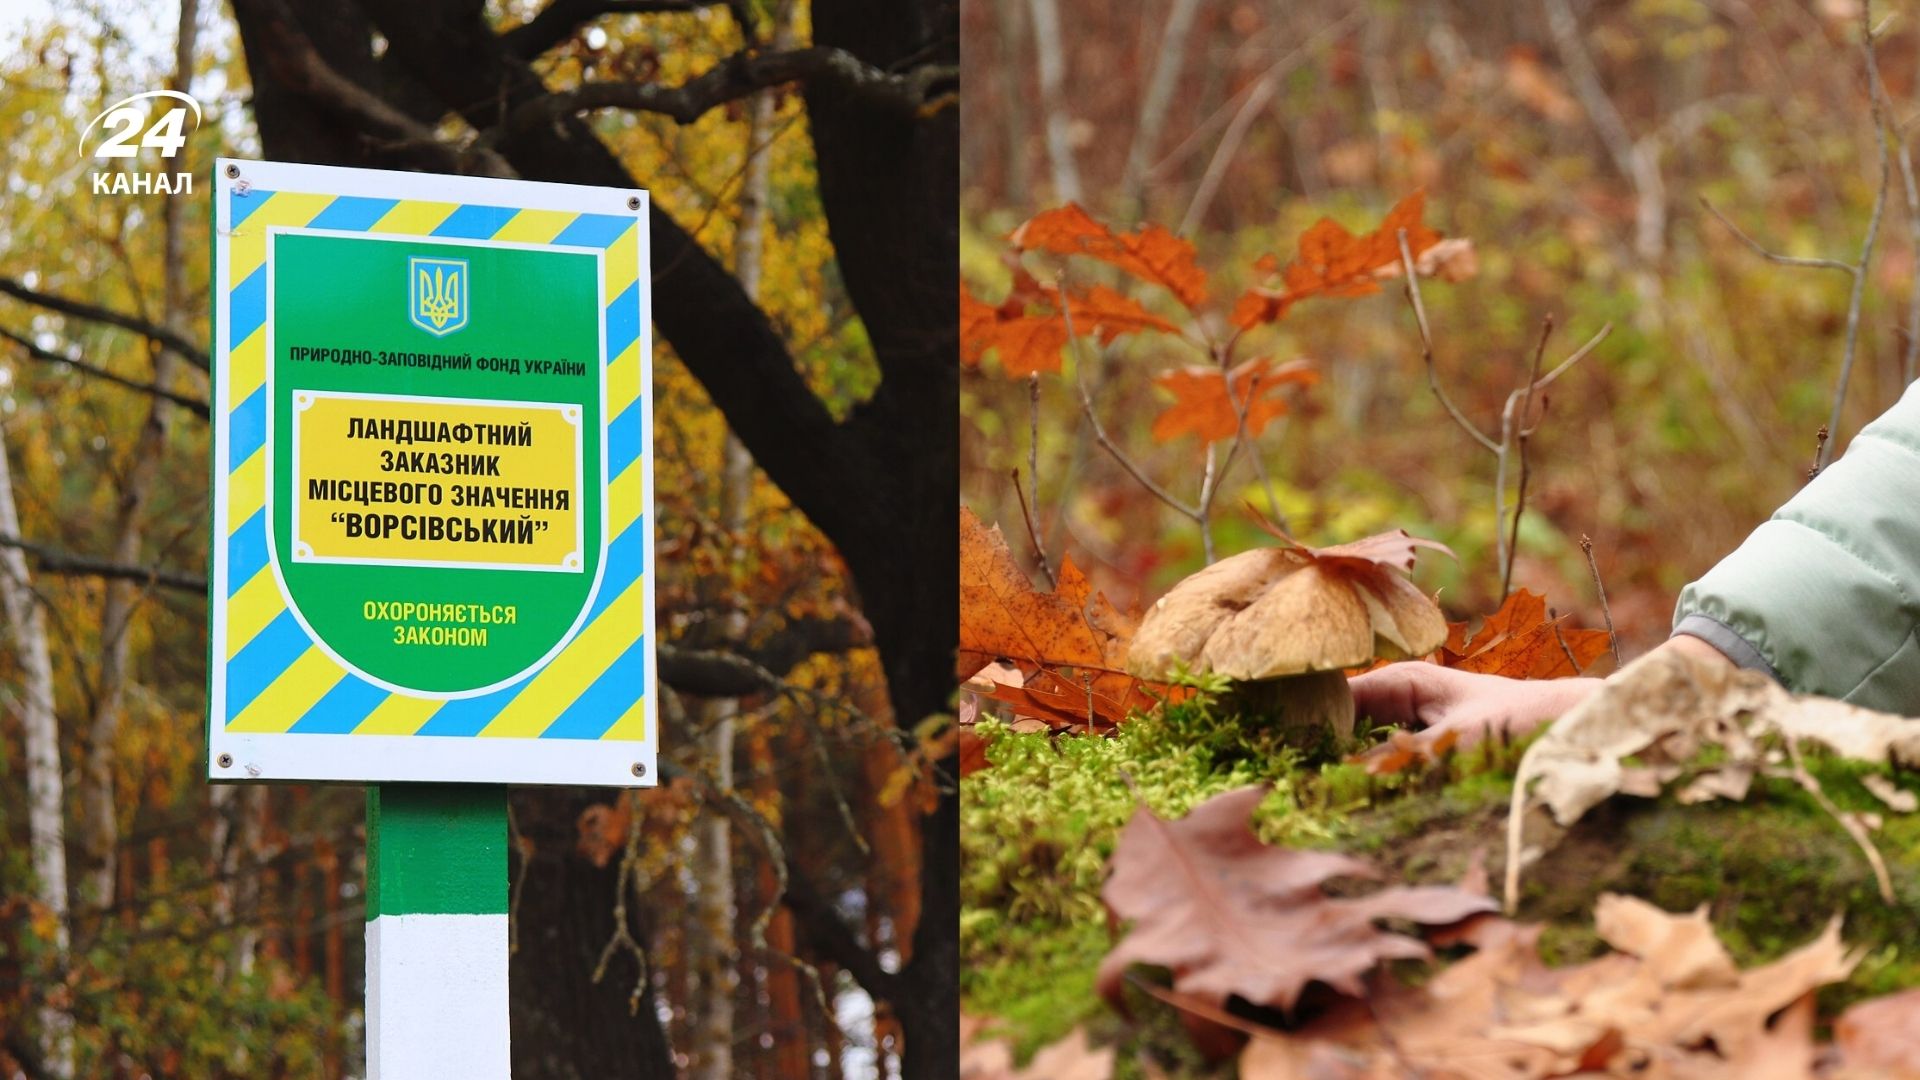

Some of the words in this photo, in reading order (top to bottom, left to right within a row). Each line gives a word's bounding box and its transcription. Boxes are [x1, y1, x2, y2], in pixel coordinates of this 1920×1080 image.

[290, 346, 472, 371] ПРИРОДНО-ЗАПОВІДНИЙ
[476, 357, 521, 375] ФОНД
[525, 358, 586, 376] УКРАЇНИ
[347, 417, 532, 447] ЛАНДШАФТНИЙ
[380, 450, 501, 477] ЗАКАЗНИК
[308, 478, 443, 506] МІСЦЕВОГО
[451, 484, 570, 511] ЗНАЧЕННЯ
[363, 601, 517, 625] ОХОРОНЯЄТЬСЯ
[393, 625, 488, 647] ЗАКОНОМ
